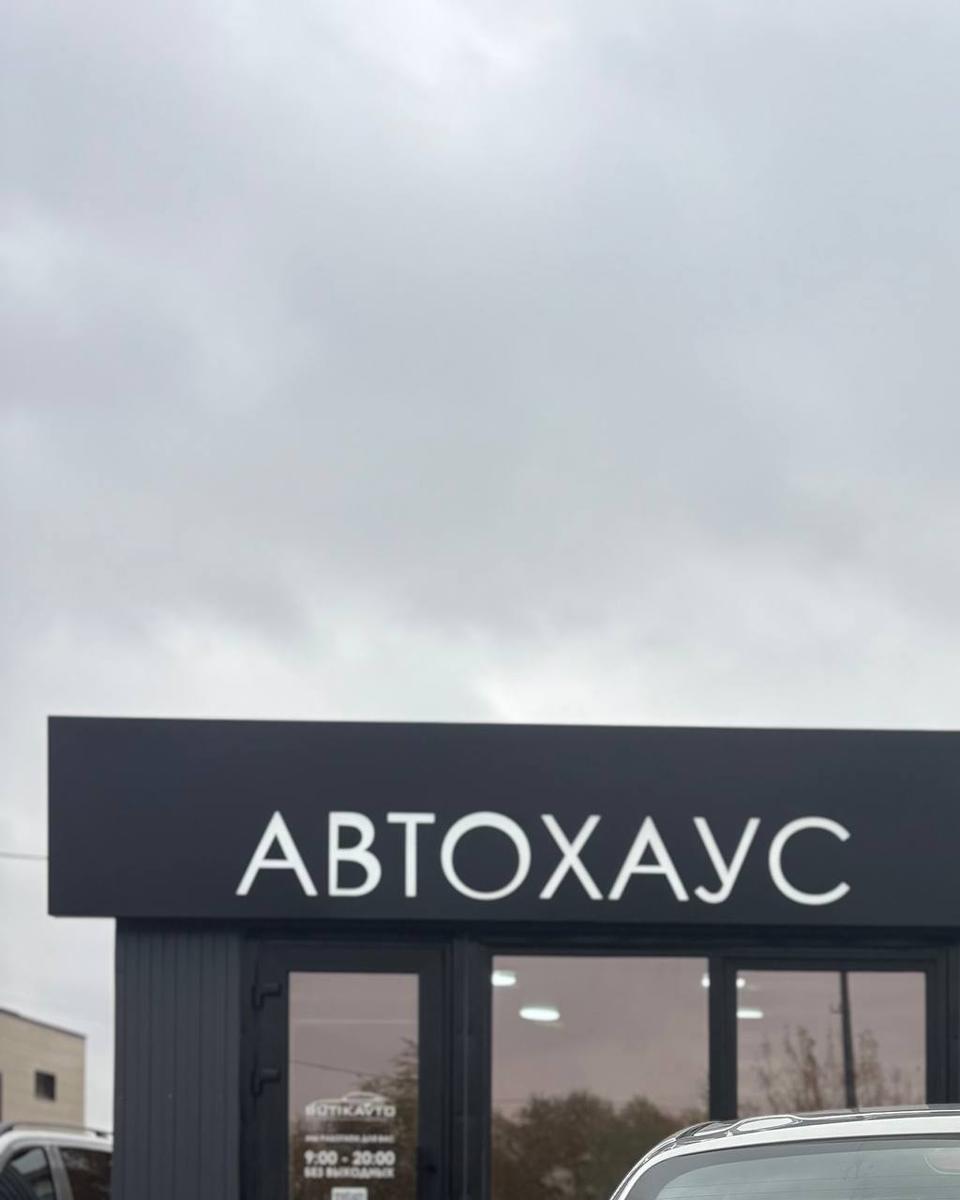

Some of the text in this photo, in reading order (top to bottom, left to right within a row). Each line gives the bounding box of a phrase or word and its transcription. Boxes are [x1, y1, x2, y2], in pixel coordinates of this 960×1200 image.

[236, 810, 851, 905] АВТОХАУС
[304, 1150, 338, 1165] 9:00
[352, 1150, 395, 1165] 20:00
